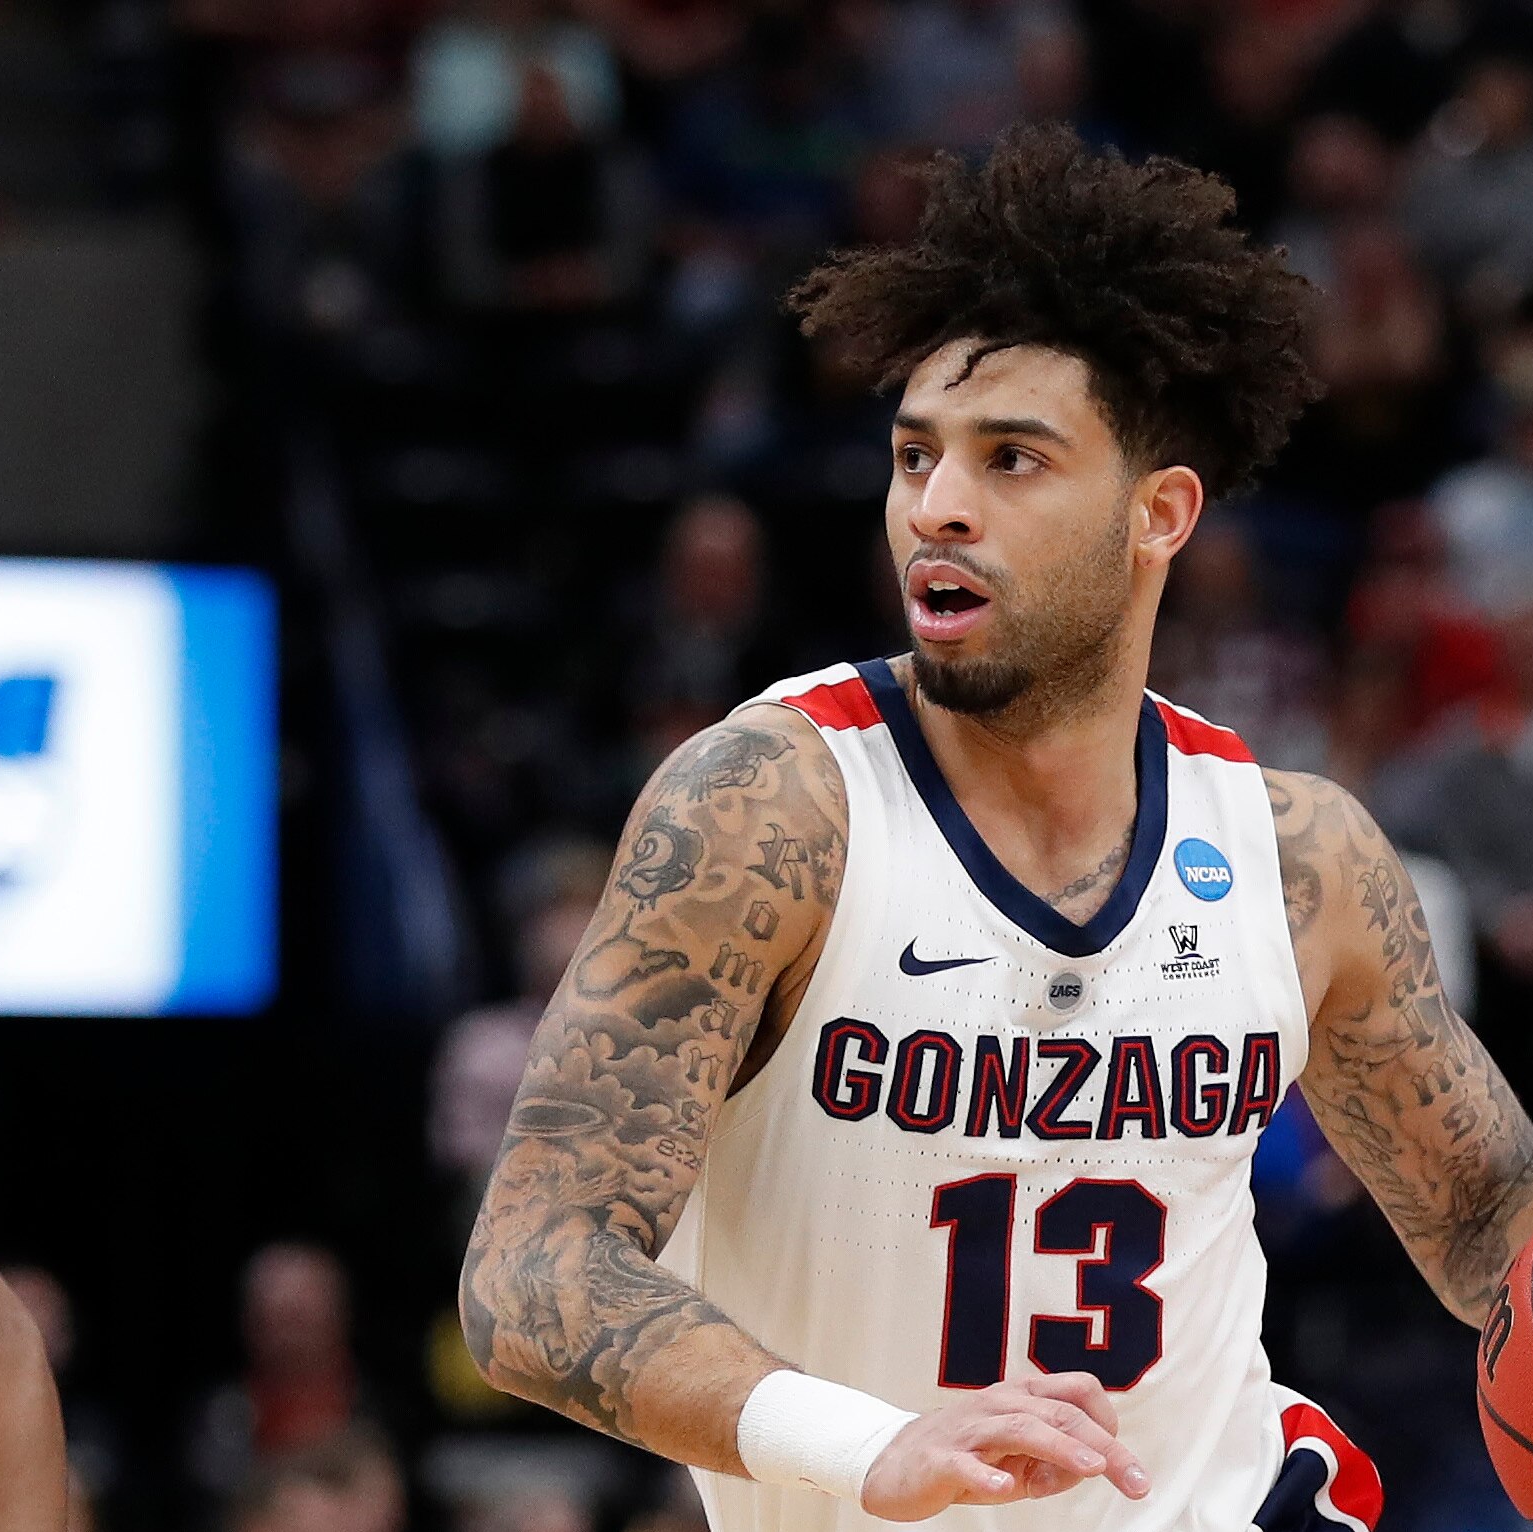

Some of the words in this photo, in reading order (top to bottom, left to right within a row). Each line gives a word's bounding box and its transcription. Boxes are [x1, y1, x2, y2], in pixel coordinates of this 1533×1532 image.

[1184, 866, 1232, 883] NCAA
[1161, 962, 1190, 974] WEST
[1191, 958, 1221, 971] COAST
[1163, 968, 1221, 981] CONFERENCE
[1050, 984, 1081, 998] ZAGS
[811, 1016, 1281, 1140] GONZAGA
[656, 1138, 704, 1170] 8:2
[929, 1171, 1168, 1392] 13
